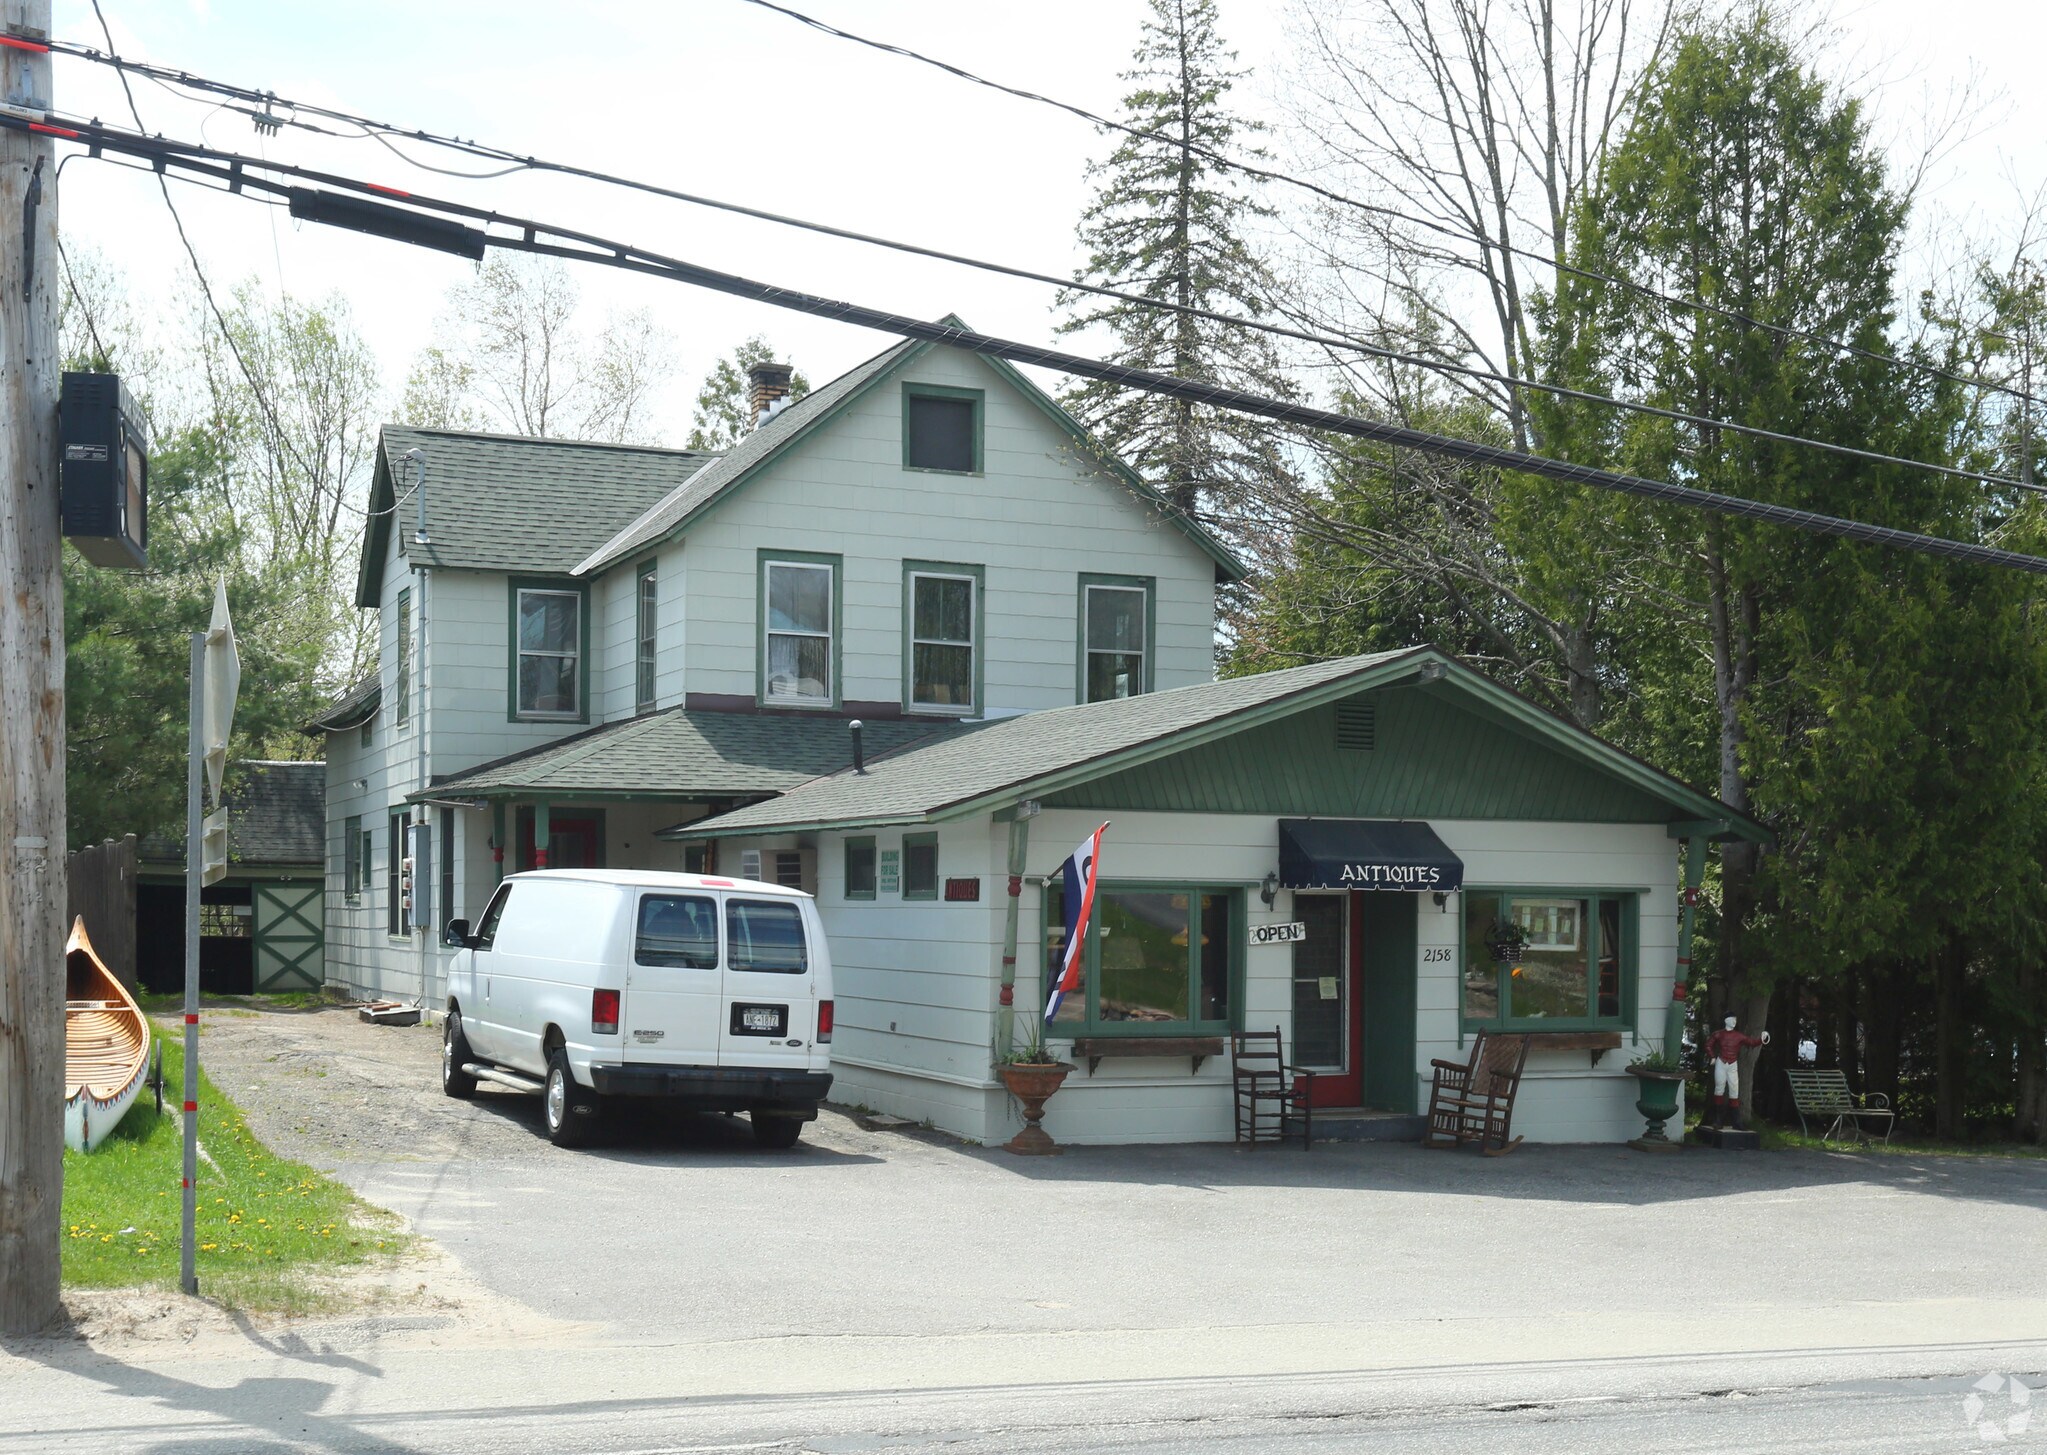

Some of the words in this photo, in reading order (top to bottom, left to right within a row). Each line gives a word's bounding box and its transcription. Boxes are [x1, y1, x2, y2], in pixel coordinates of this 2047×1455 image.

[1340, 864, 1440, 883] ANTIQUES
[946, 879, 976, 899] NTIQUES
[1257, 925, 1298, 941] OPEN
[1424, 949, 1451, 962] 2158
